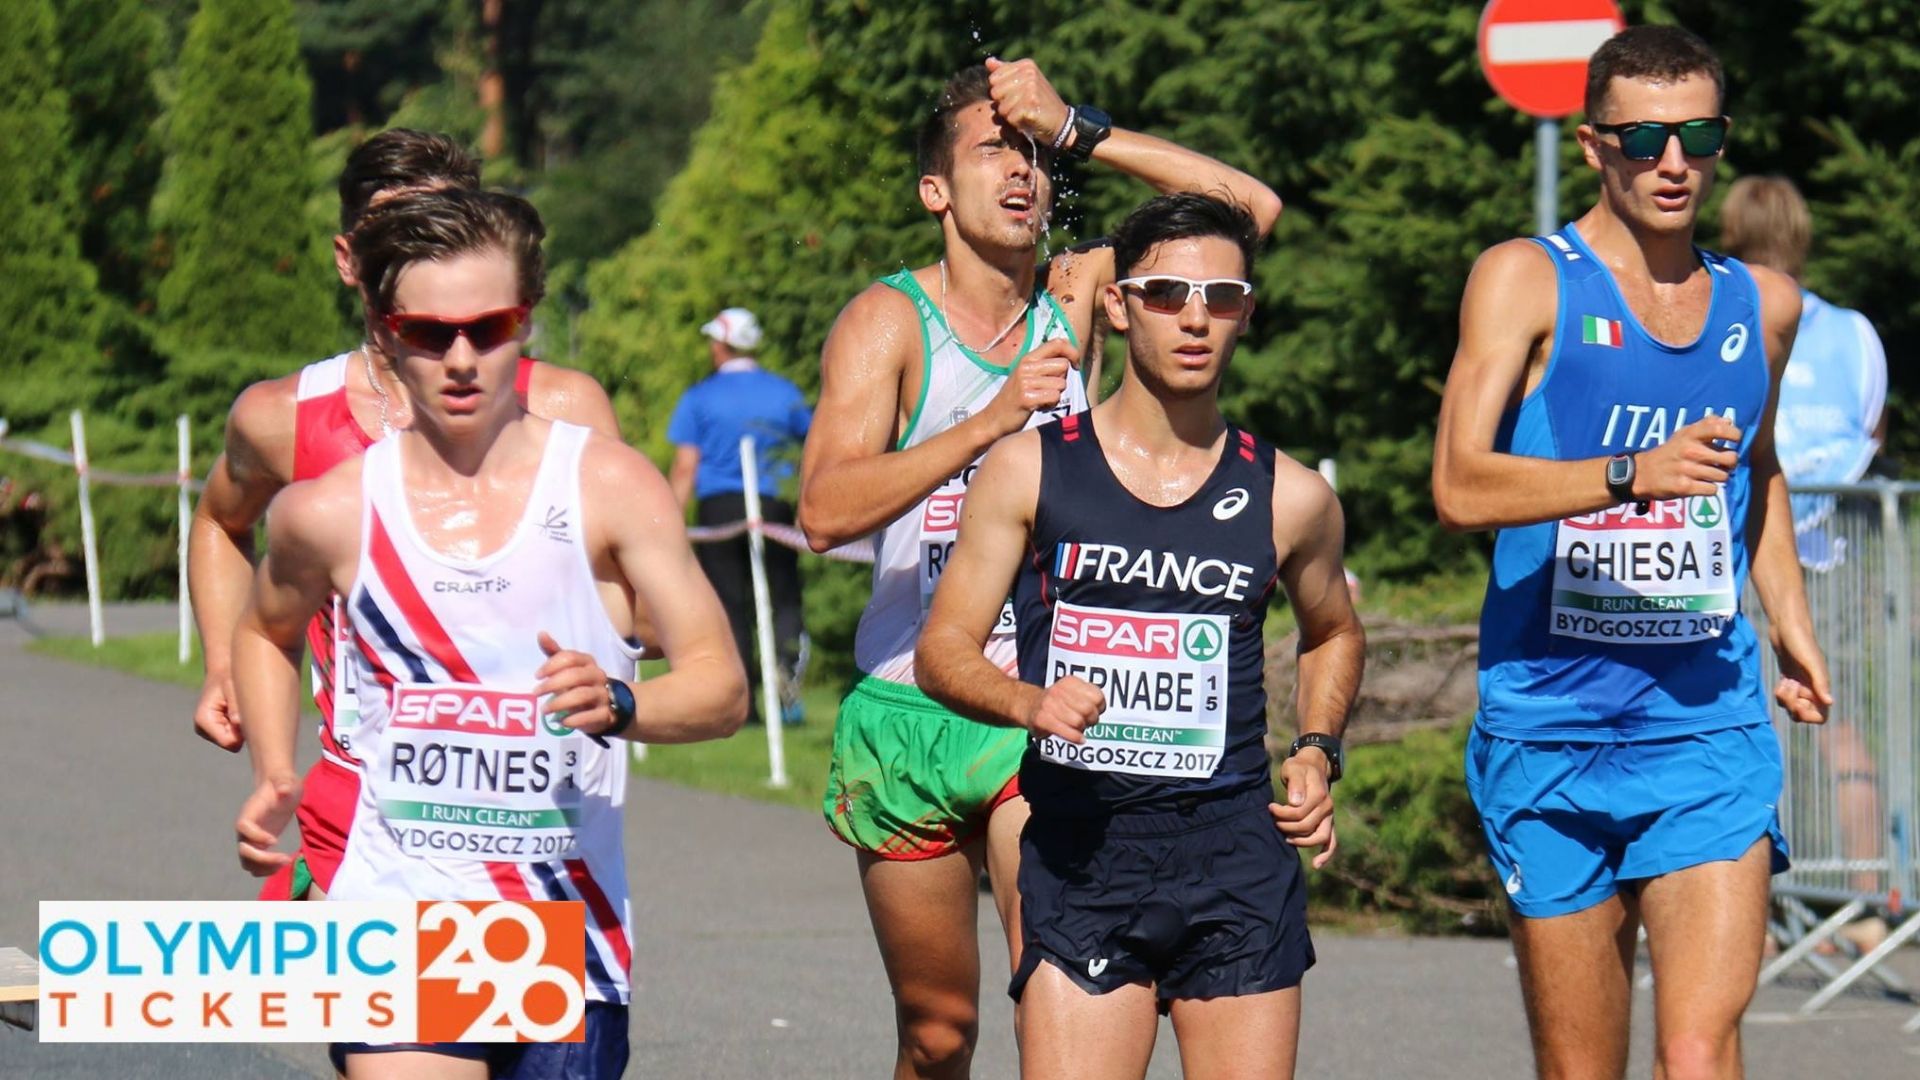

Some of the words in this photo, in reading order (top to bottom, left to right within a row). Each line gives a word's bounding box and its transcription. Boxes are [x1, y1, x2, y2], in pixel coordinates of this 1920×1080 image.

[1601, 404, 1738, 449] ITA
[1073, 543, 1254, 601] FRANCE
[1566, 540, 1701, 582] CHIESA
[433, 579, 494, 593] CRAFT
[1602, 599, 1635, 611] RUN
[1054, 613, 1176, 654] SPAR
[1556, 612, 1683, 638] BYDGOSZCZ
[1053, 662, 1194, 713] RNABE
[395, 693, 533, 731] SPAR
[390, 741, 551, 793] RØTNES
[1045, 738, 1167, 769] BYDGOSZCZ
[1172, 752, 1217, 771] 2017
[432, 805, 470, 821] RUN
[393, 826, 524, 855] YDGOSZCZ
[531, 835, 575, 854] 2017
